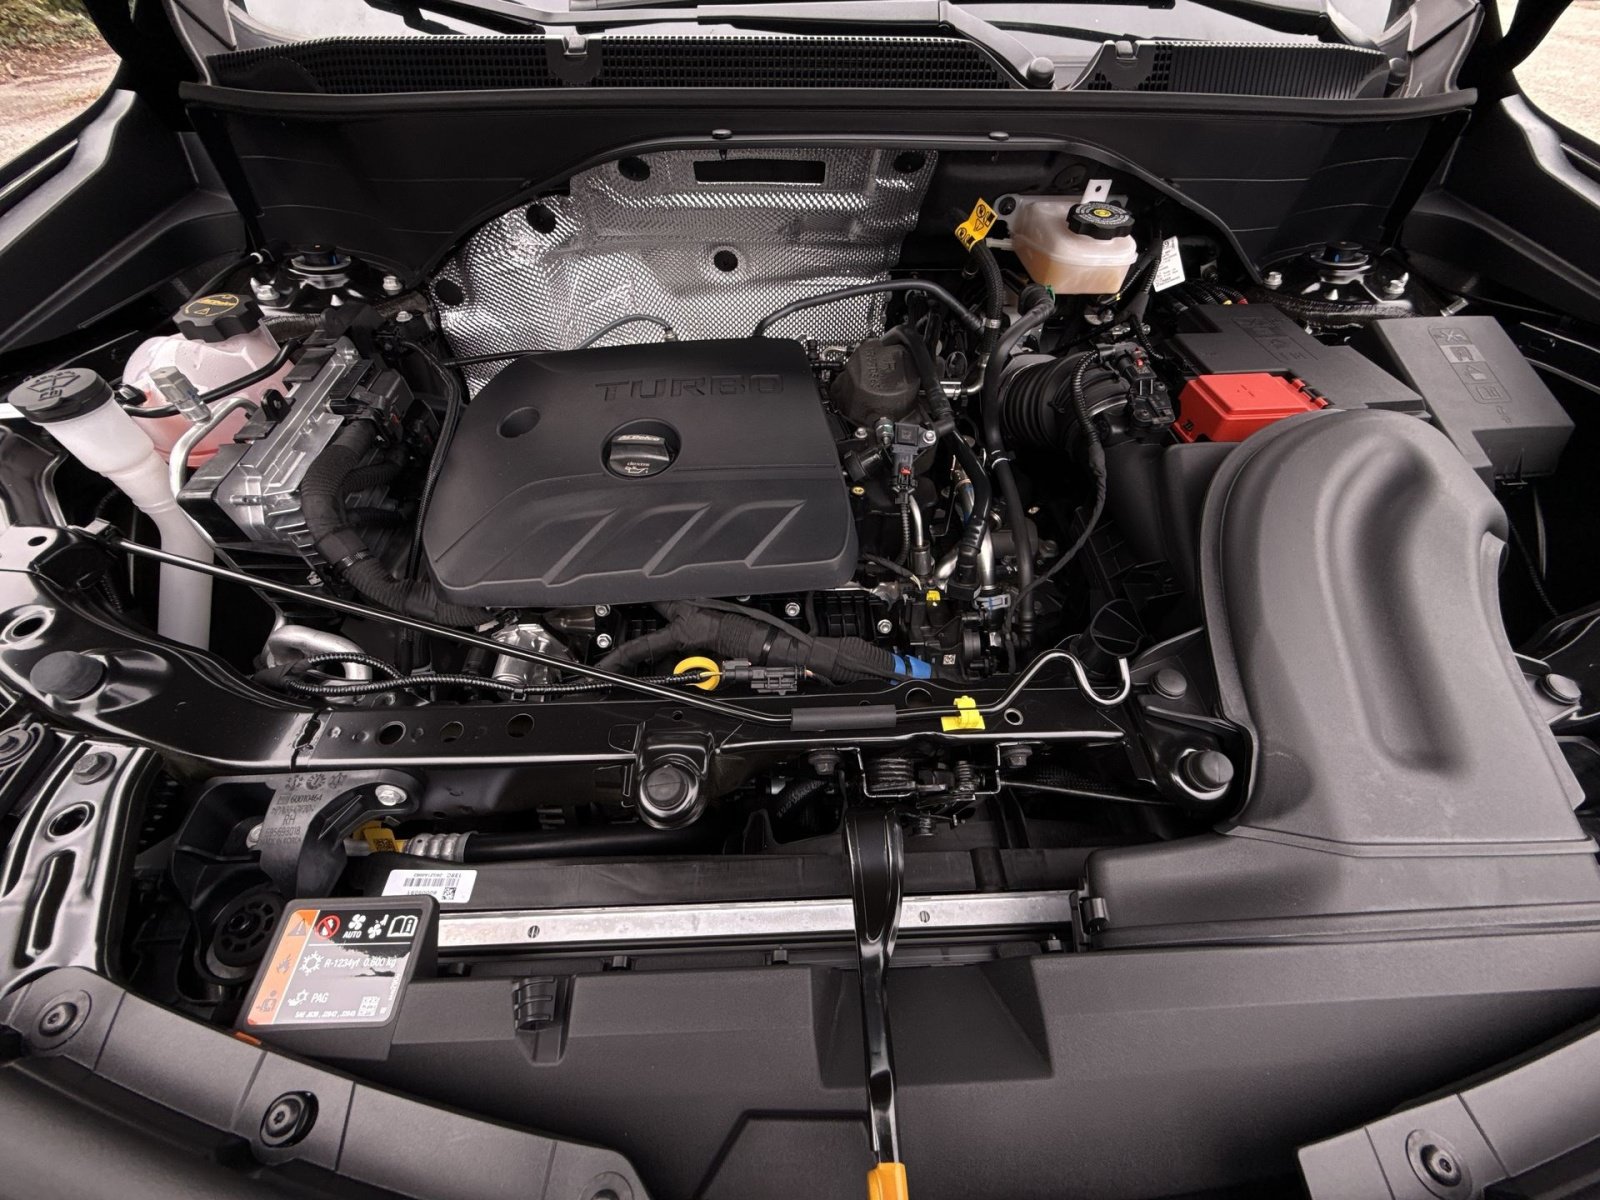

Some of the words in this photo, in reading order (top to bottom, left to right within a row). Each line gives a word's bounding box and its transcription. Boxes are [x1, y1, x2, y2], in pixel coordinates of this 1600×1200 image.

[595, 374, 784, 401] TURBO
[283, 813, 296, 825] RH
[343, 930, 362, 939] AUTO
[324, 957, 360, 969] R-1234yf
[386, 955, 397, 968] kg
[311, 992, 329, 1003] PAG
